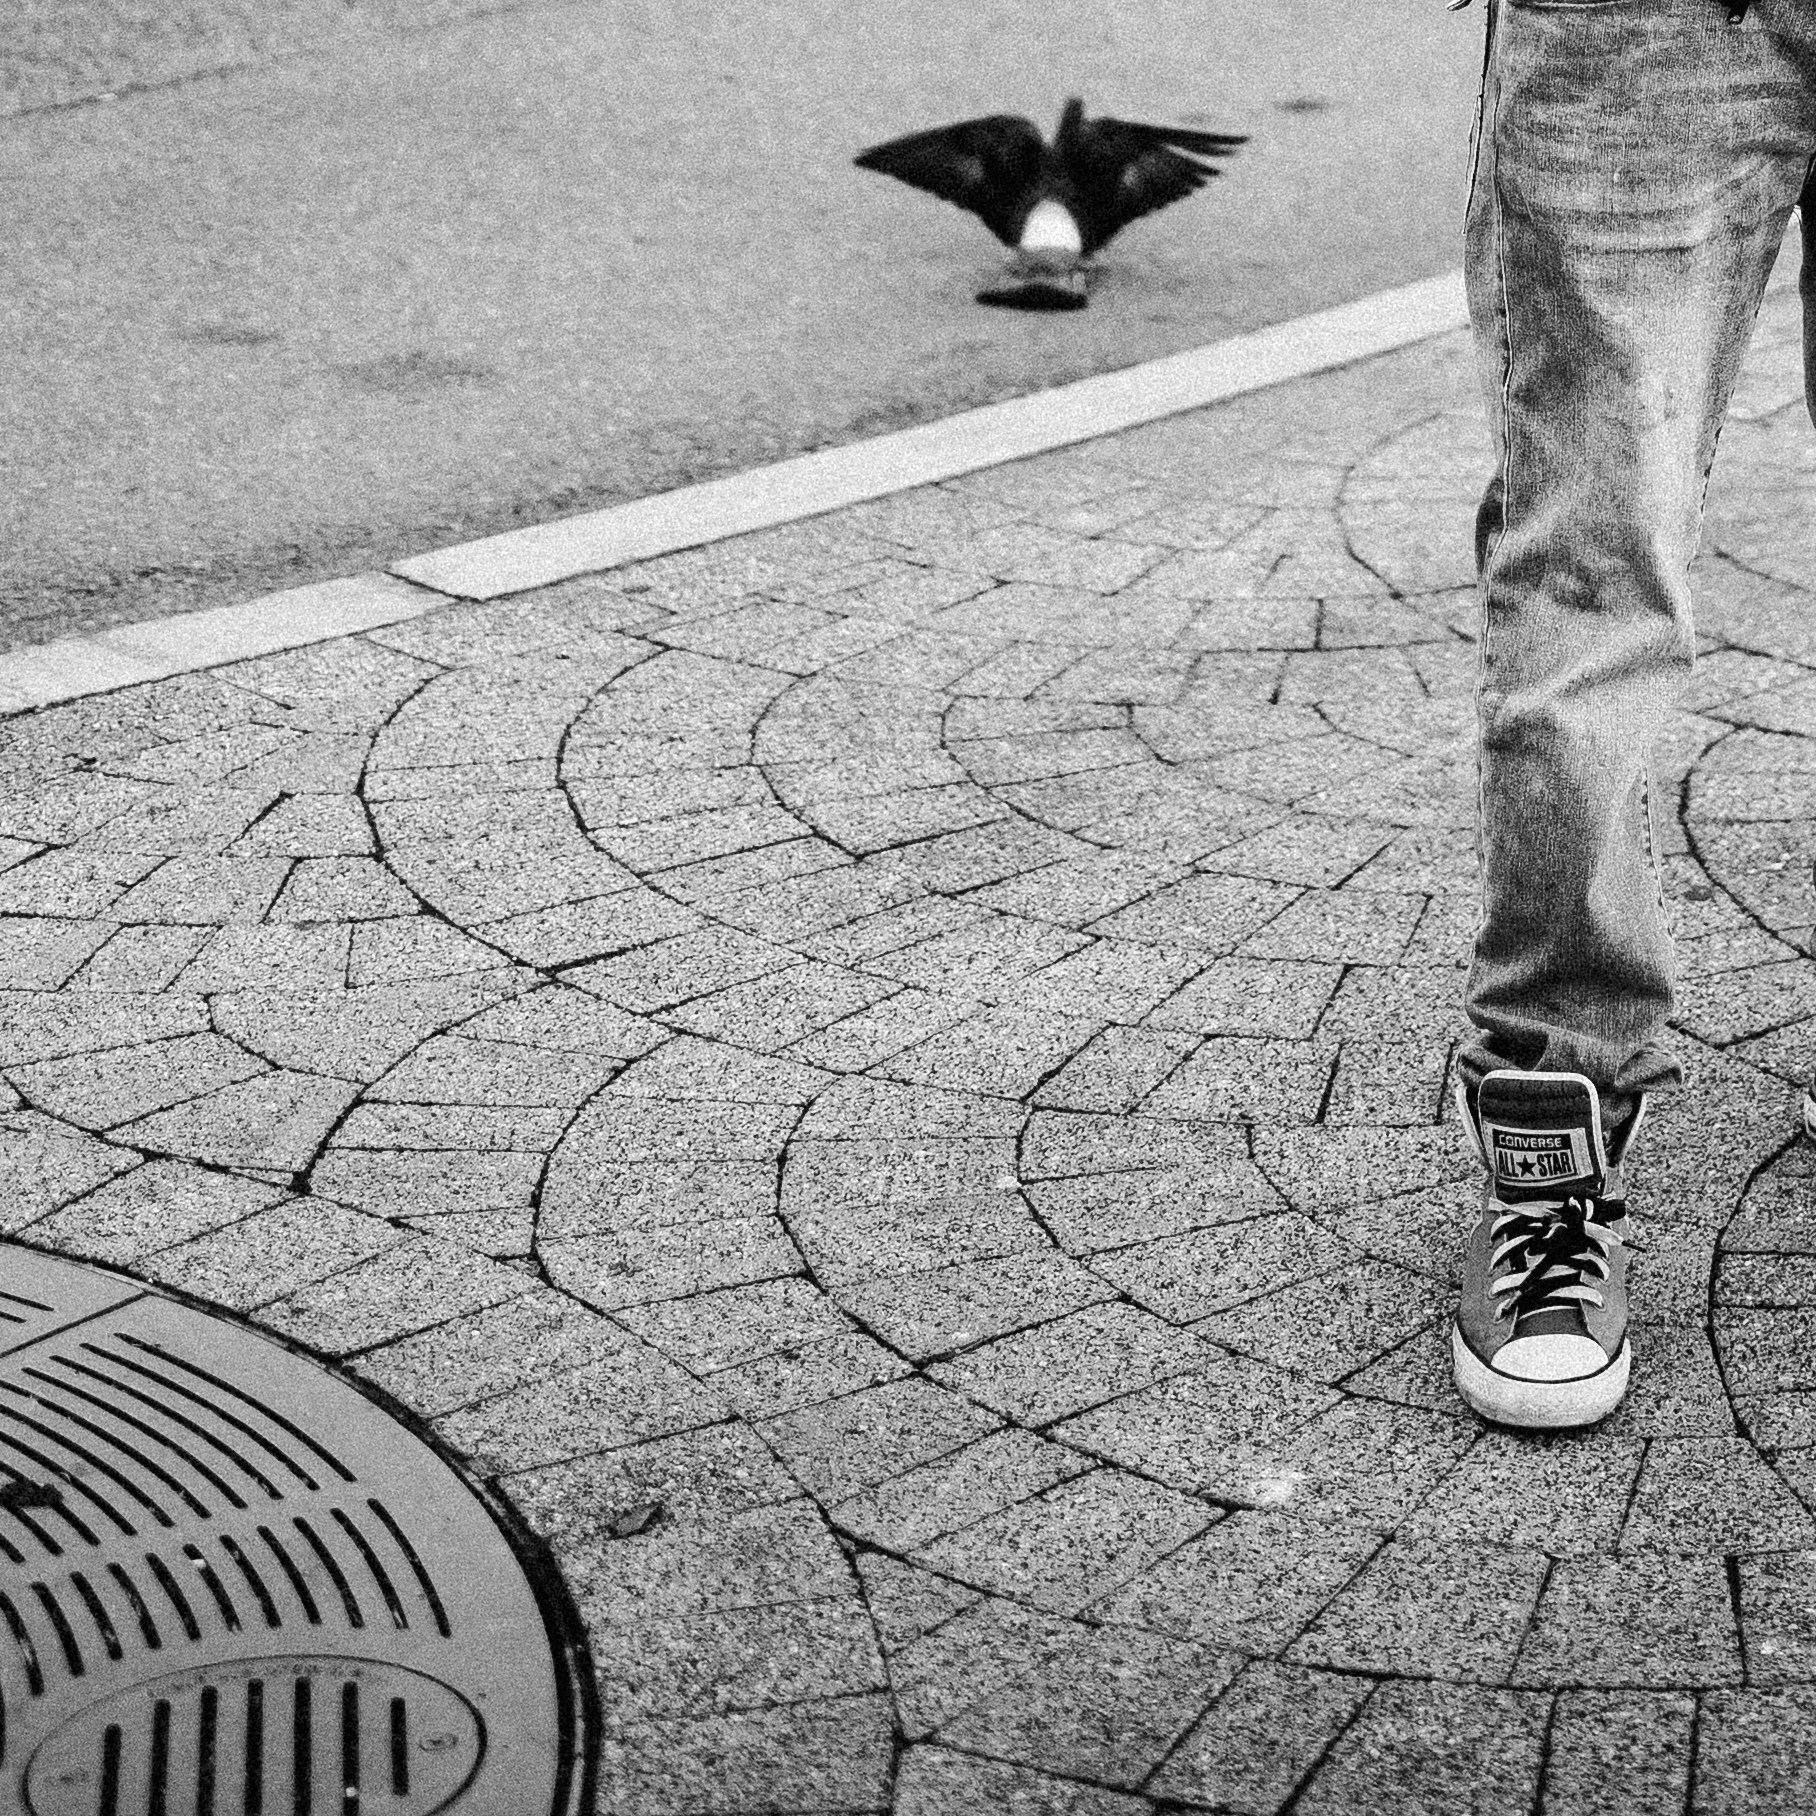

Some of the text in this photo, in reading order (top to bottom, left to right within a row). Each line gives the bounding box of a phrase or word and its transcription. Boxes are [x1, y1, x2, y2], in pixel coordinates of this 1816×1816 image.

[1499, 1134, 1562, 1148] CONVERSE
[1499, 1149, 1573, 1178] ALL STAR
